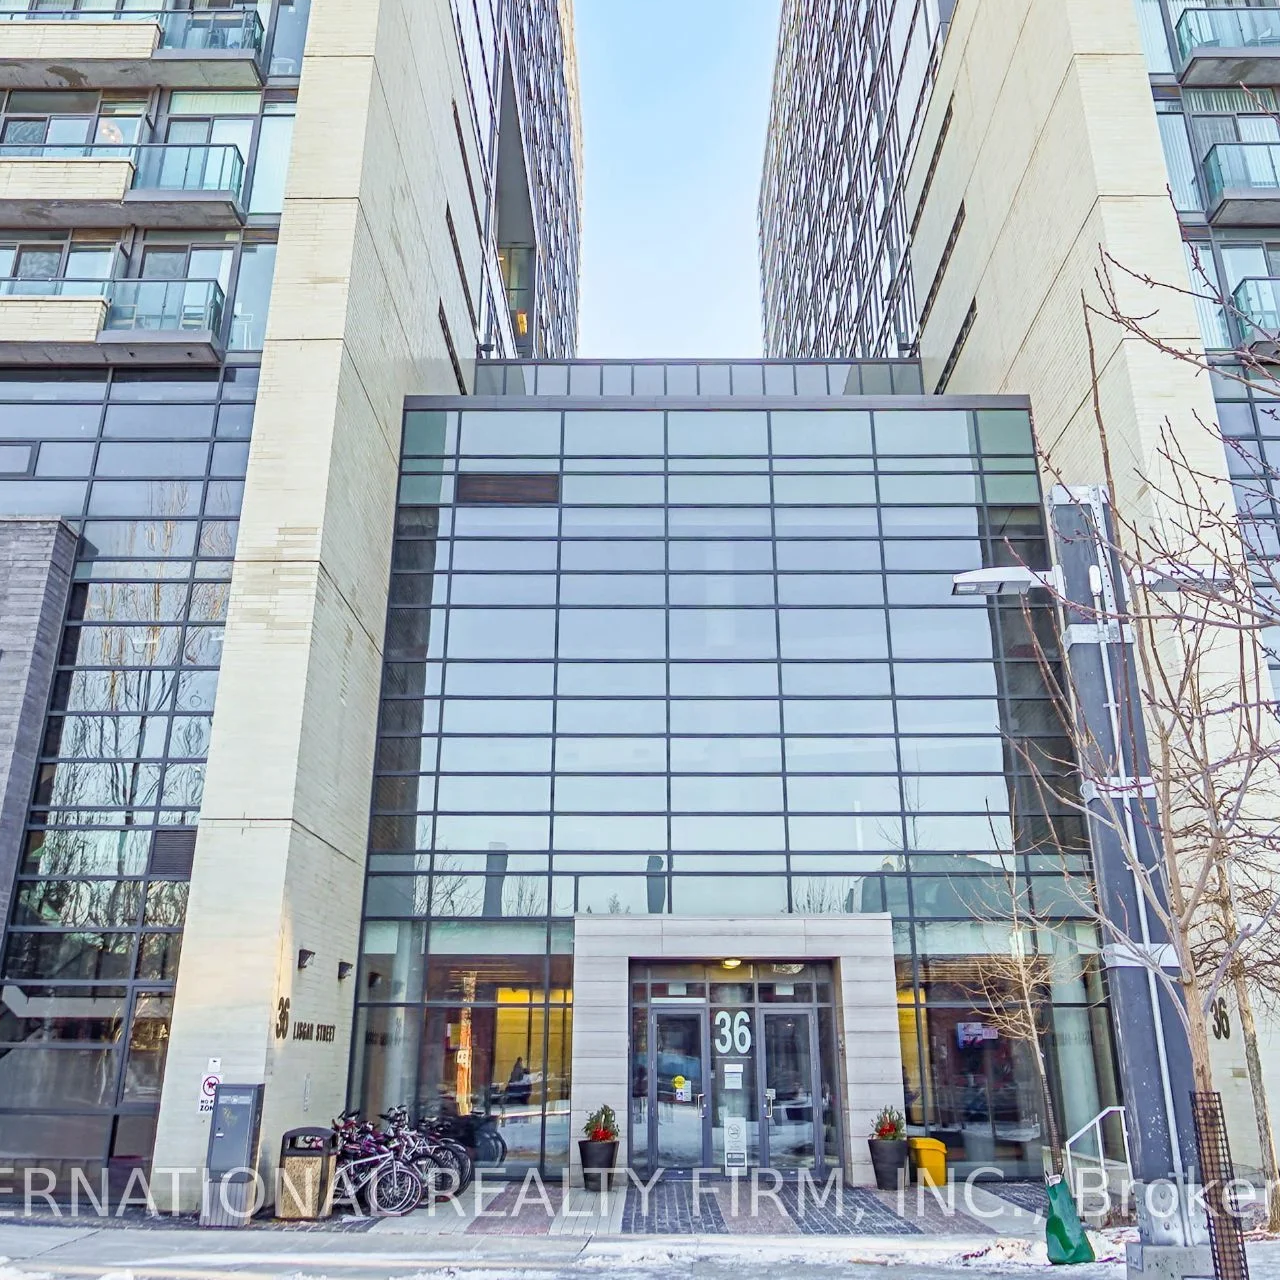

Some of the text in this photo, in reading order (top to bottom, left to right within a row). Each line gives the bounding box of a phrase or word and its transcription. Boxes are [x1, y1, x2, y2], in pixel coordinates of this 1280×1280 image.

[276, 997, 290, 1040] 36
[316, 1024, 336, 1043] STREET
[715, 1011, 752, 1054] 36
[1210, 997, 1230, 1040] 36
